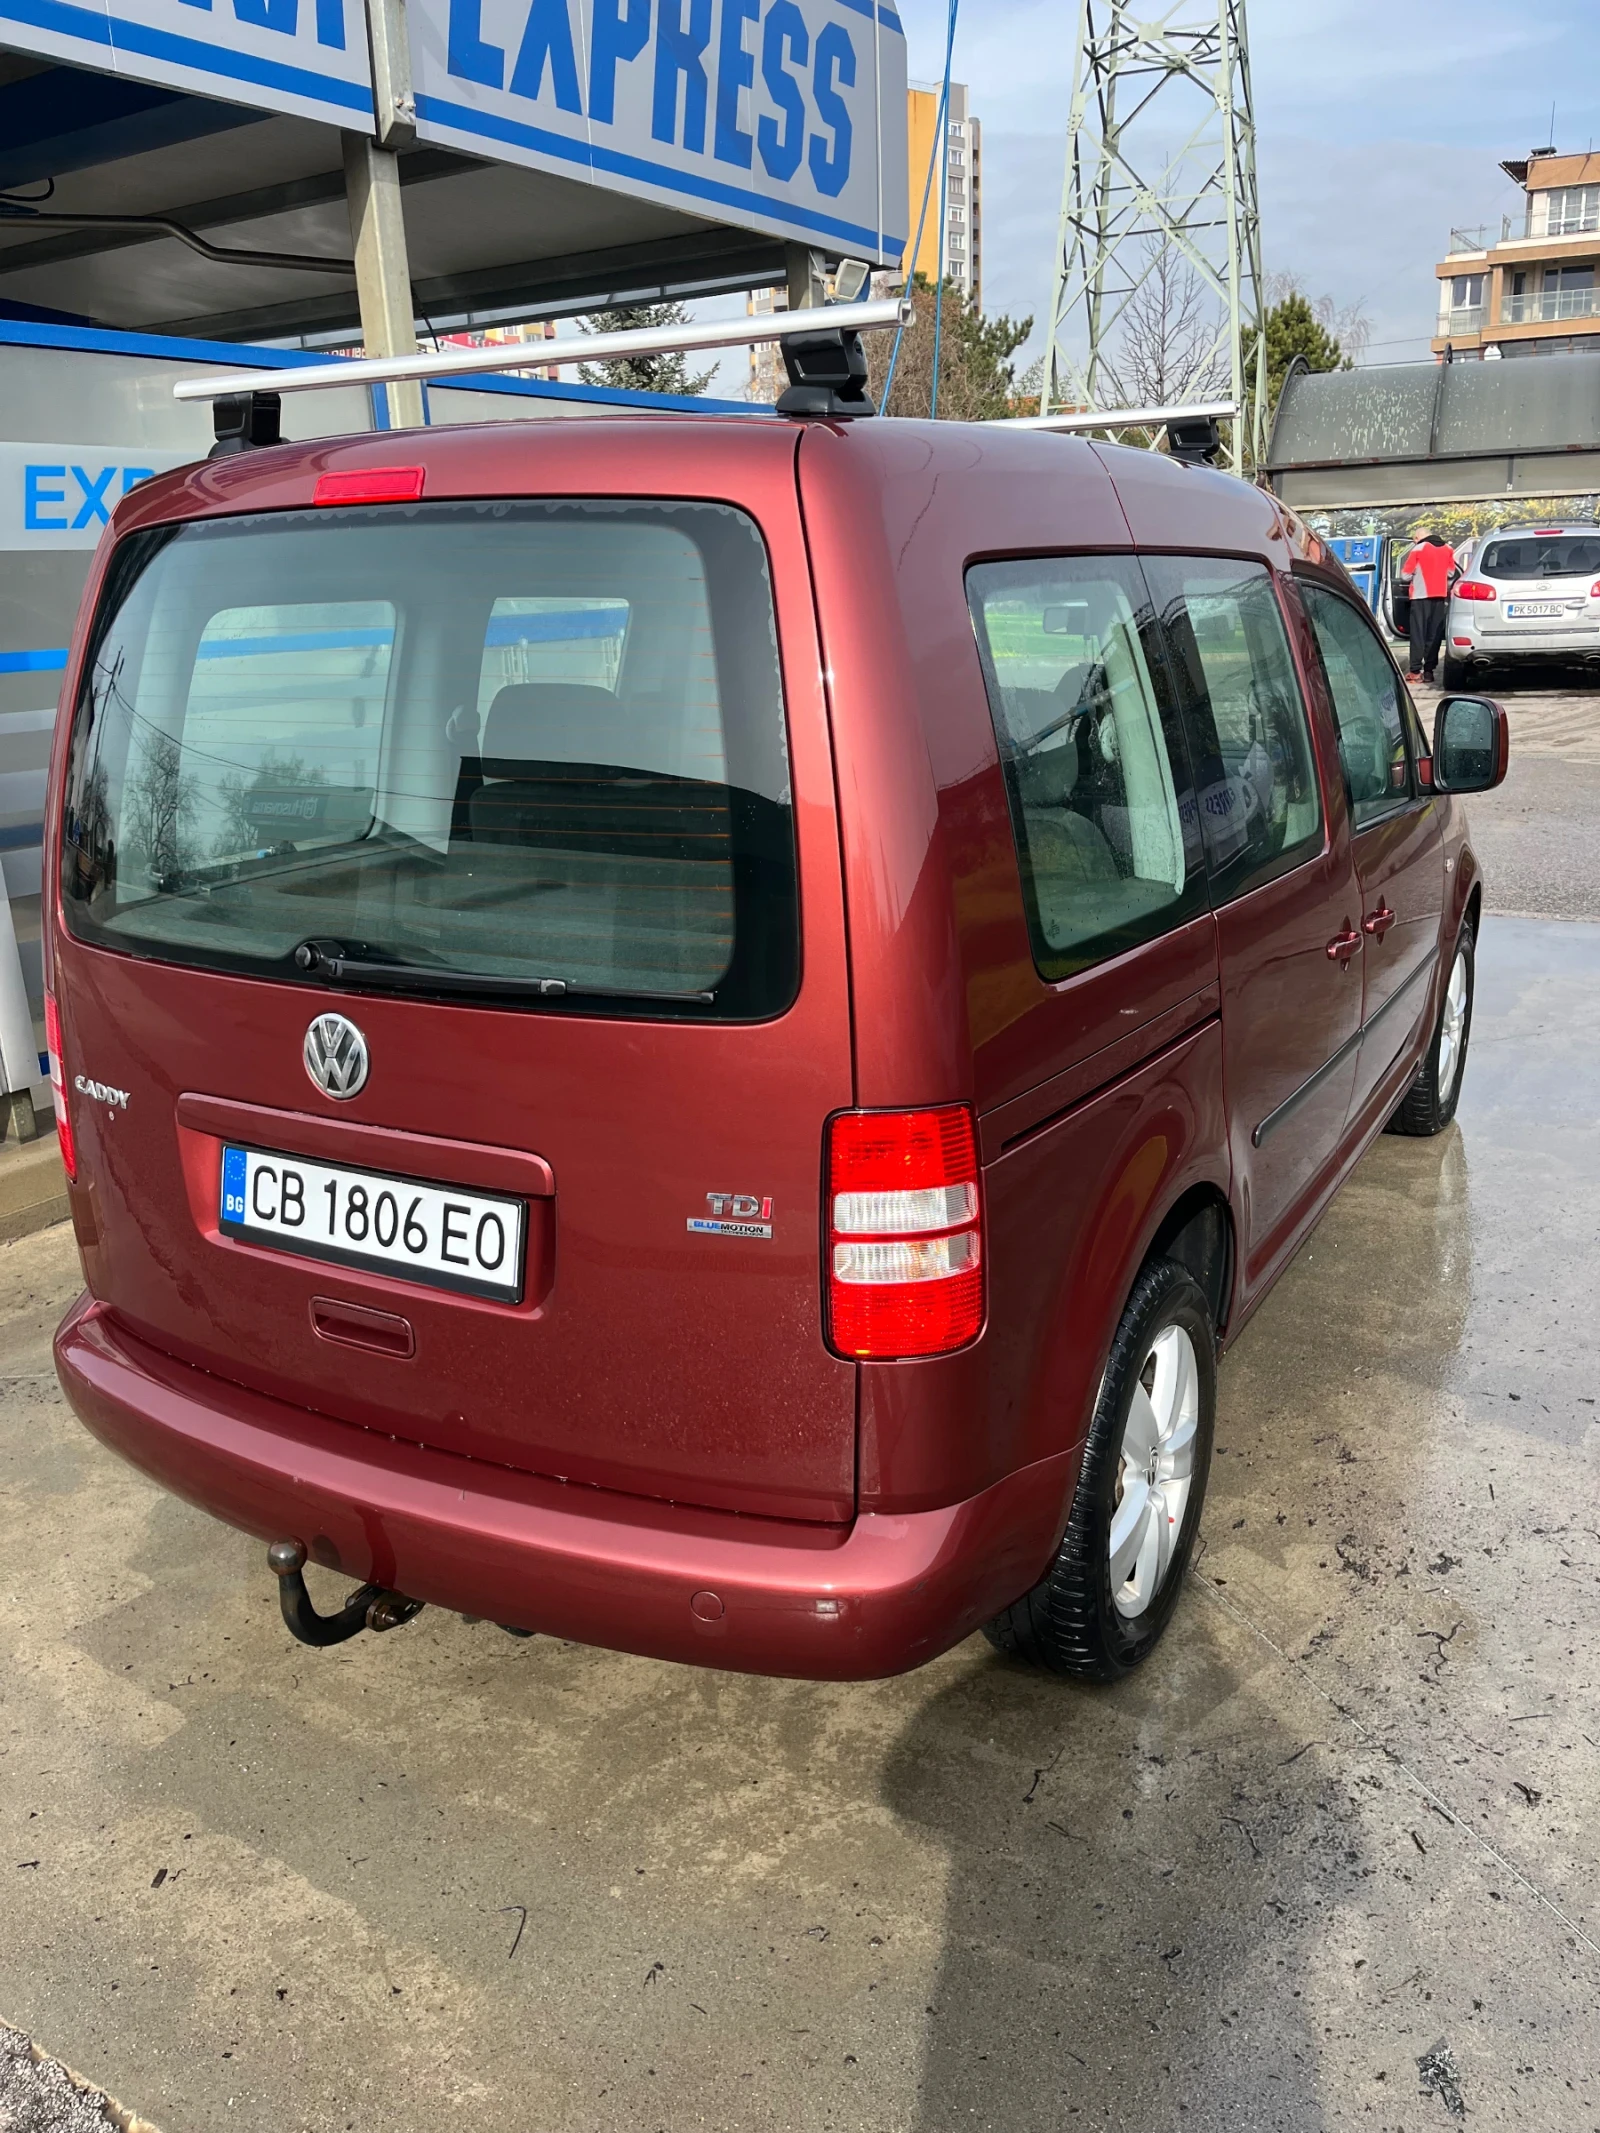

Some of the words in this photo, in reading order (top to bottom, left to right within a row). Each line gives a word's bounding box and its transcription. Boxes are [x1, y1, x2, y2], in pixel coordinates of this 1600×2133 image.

[1514, 606, 1526, 614] PK
[1527, 605, 1548, 614] 5017
[1550, 605, 1561, 613] BC
[74, 1074, 132, 1110] CADDY
[226, 1193, 244, 1214] BG
[706, 1192, 773, 1219] TDI
[252, 1164, 306, 1227] CB
[323, 1178, 428, 1254] 1806
[440, 1201, 506, 1271] EO
[693, 1220, 763, 1233] BLUEMOTION
